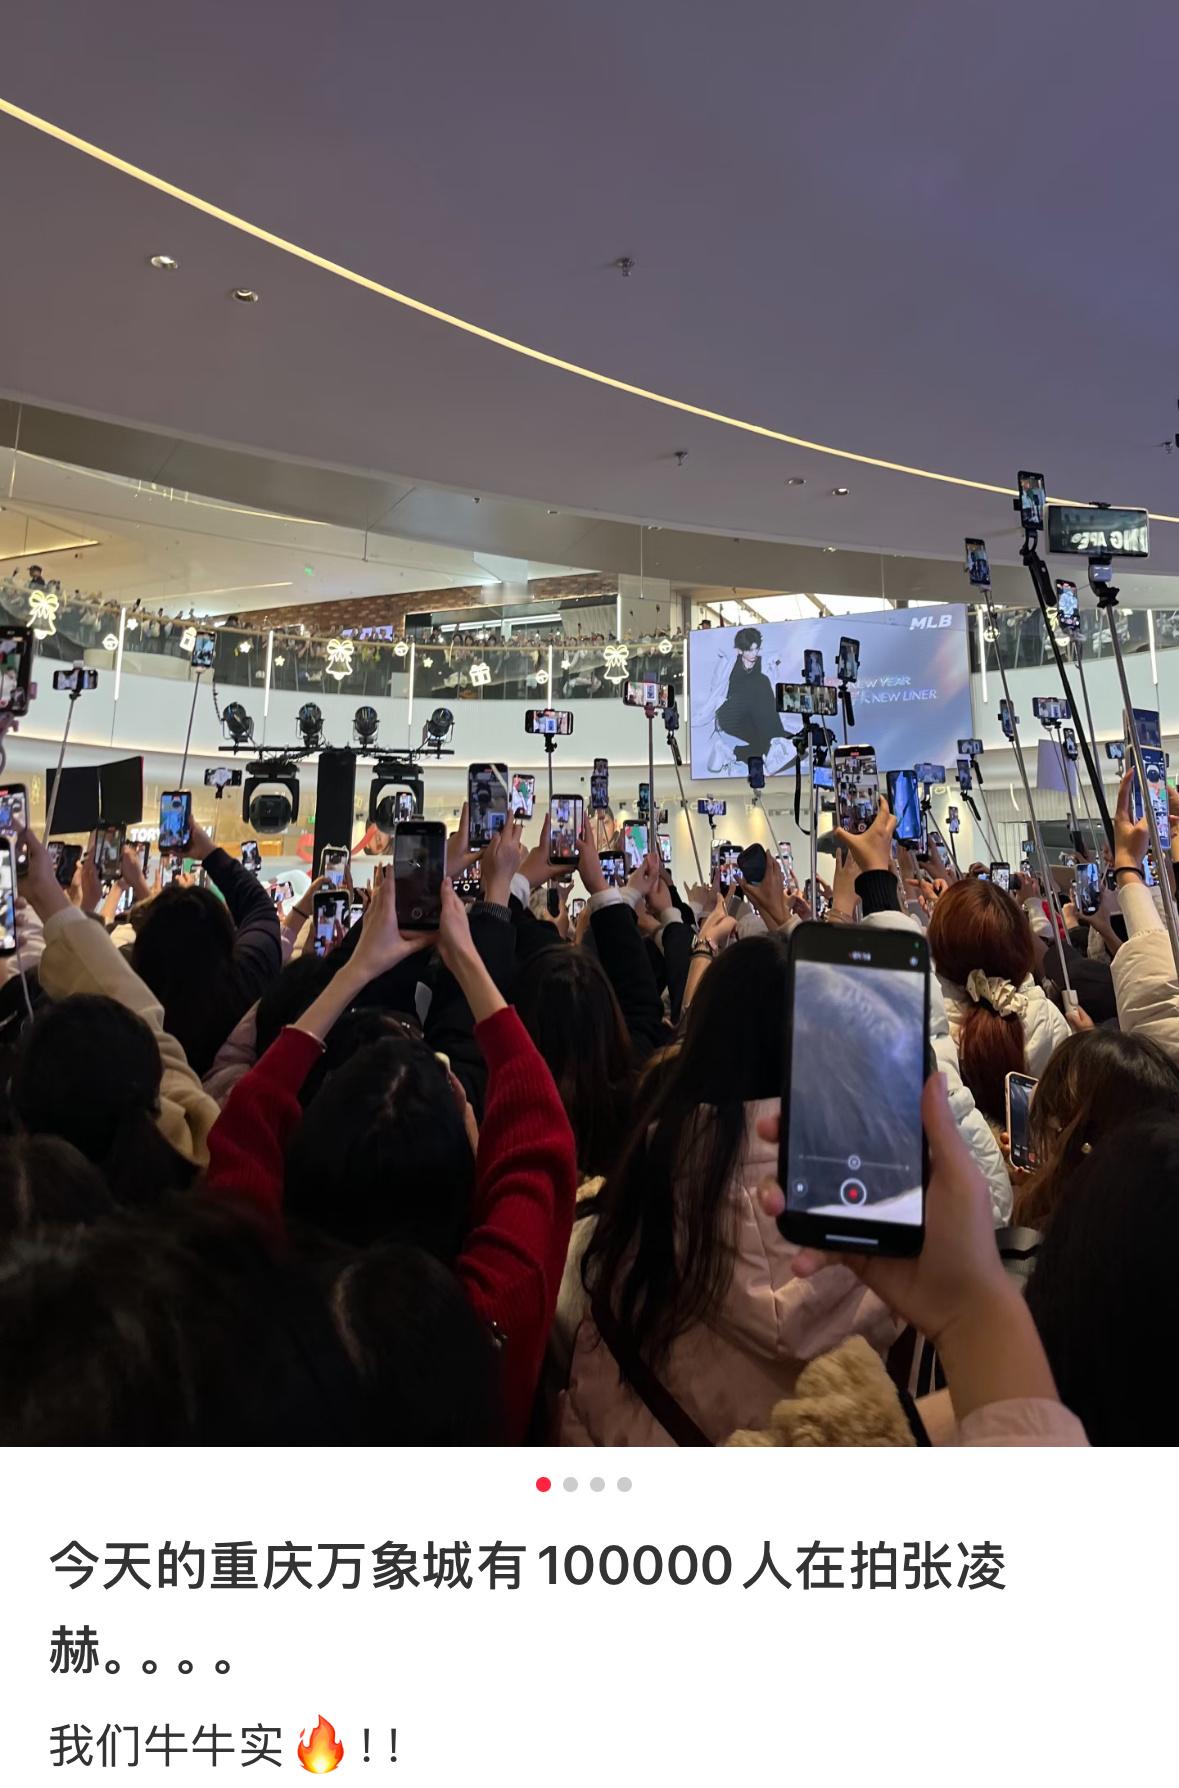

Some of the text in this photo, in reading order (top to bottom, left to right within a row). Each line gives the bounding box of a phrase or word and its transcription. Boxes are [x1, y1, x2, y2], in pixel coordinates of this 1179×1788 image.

[909, 614, 953, 630] MLB
[879, 675, 912, 688] YEAR
[872, 691, 901, 704] NEW
[902, 687, 937, 701] LINER
